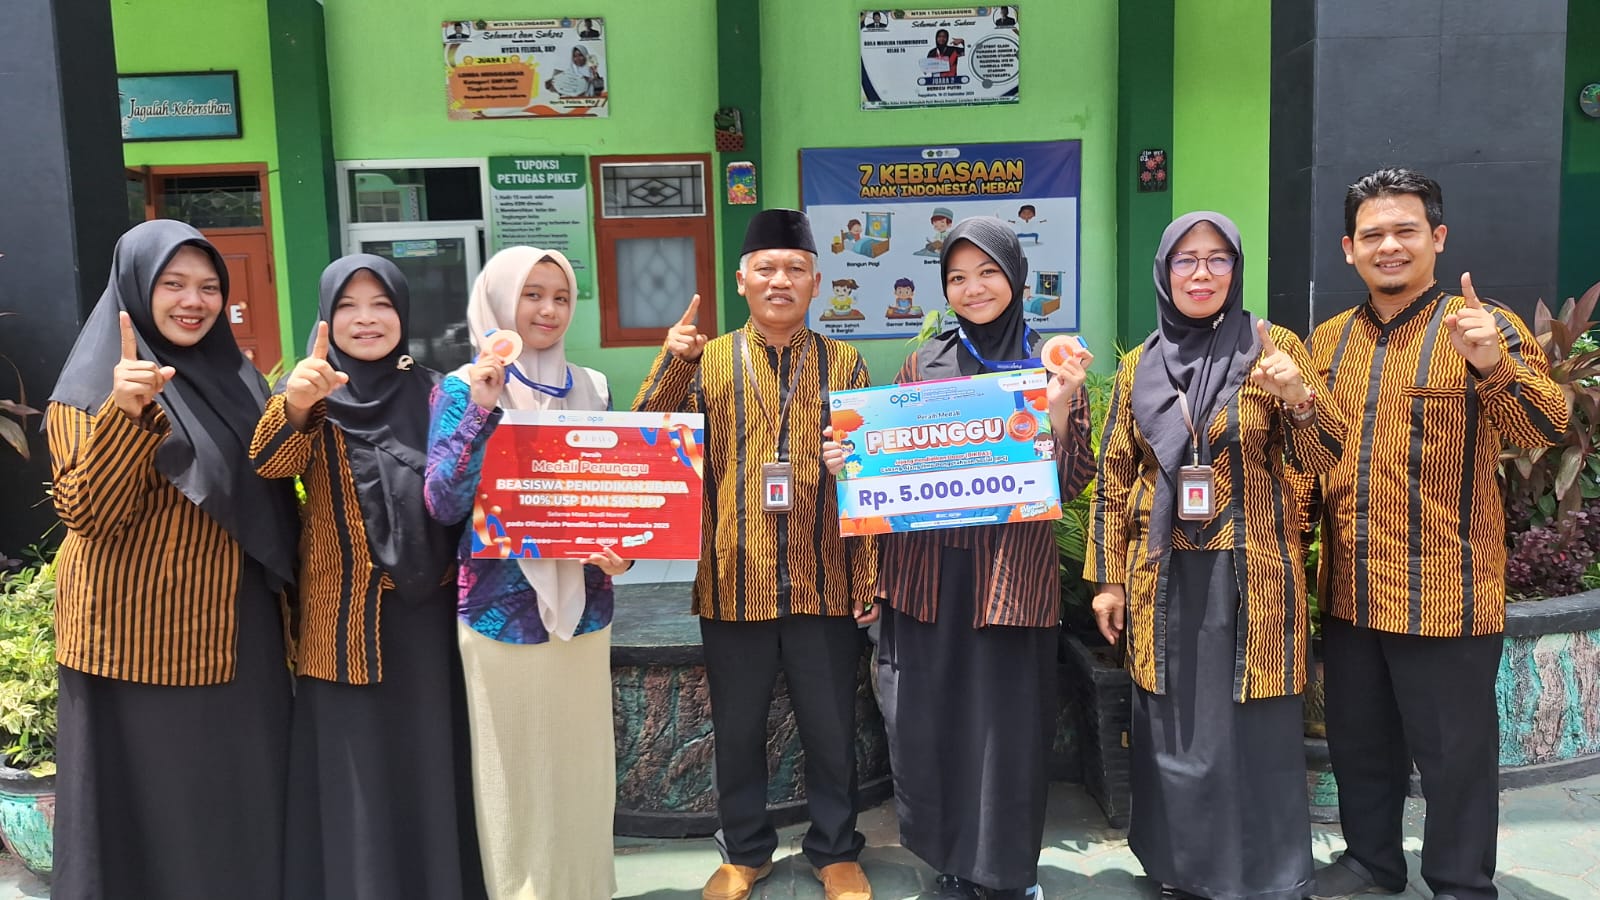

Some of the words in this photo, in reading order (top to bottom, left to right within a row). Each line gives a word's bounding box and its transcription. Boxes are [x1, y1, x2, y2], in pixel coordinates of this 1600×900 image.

[482, 31, 517, 40] Selamat
[518, 31, 533, 39] dan
[127, 98, 170, 121] Jagalah
[171, 99, 233, 116] Kebersihan
[514, 159, 560, 170] TUPOKSI
[858, 163, 874, 186] 7
[879, 160, 1024, 185] KEBIASAAN
[497, 174, 546, 184] PETUGAS
[547, 173, 578, 183] PIKET
[860, 184, 898, 198] ANAK
[899, 183, 978, 197] INDONESIA
[981, 181, 1023, 194] HEBAT
[890, 387, 921, 408] opsi
[938, 410, 961, 418] Medali
[865, 416, 1006, 454] PERUNGGU
[532, 459, 579, 473] Medali
[580, 460, 649, 477] Perunggu
[496, 479, 563, 491] BEASISWA
[566, 480, 644, 492] PENDIDIKAN
[858, 489, 894, 510] Rp.
[899, 475, 1036, 502] 5.000.000,-
[519, 495, 551, 506] 100%
[553, 495, 579, 506] USP
[580, 495, 610, 507] DAN
